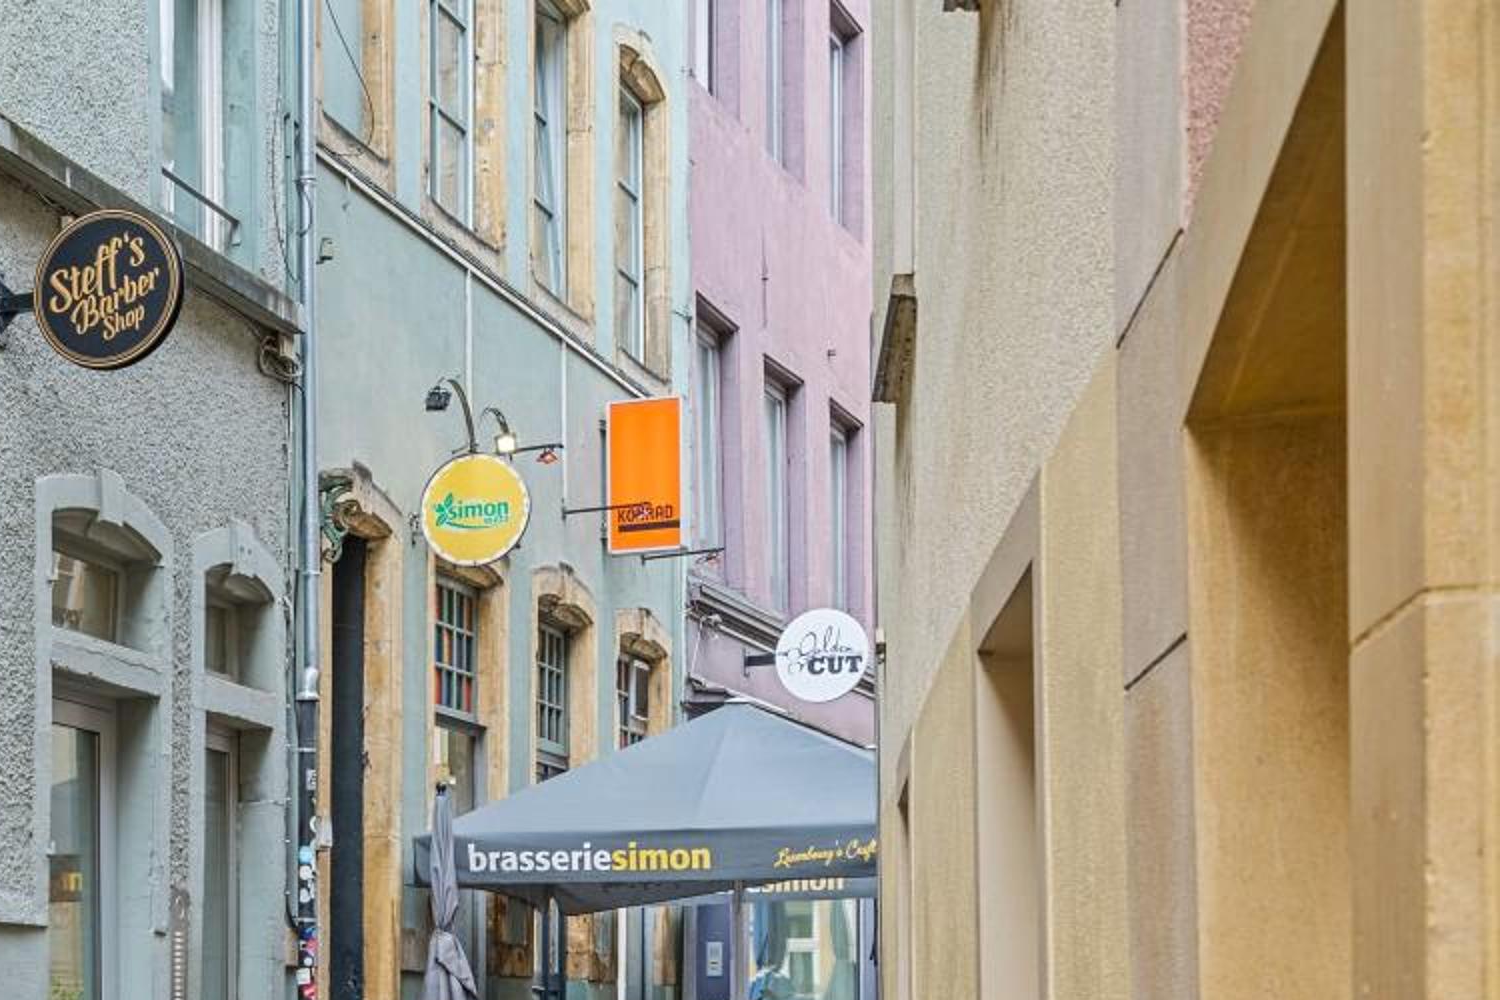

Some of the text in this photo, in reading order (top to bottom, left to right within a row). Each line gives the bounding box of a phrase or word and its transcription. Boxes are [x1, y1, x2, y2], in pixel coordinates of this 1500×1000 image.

[50, 231, 145, 313] Steff's
[71, 267, 159, 335] Barber
[103, 305, 145, 341] Shop
[448, 500, 509, 519] simon
[617, 504, 673, 523] KORAD
[807, 655, 863, 675] CUT
[467, 841, 712, 872] brasseriesimon
